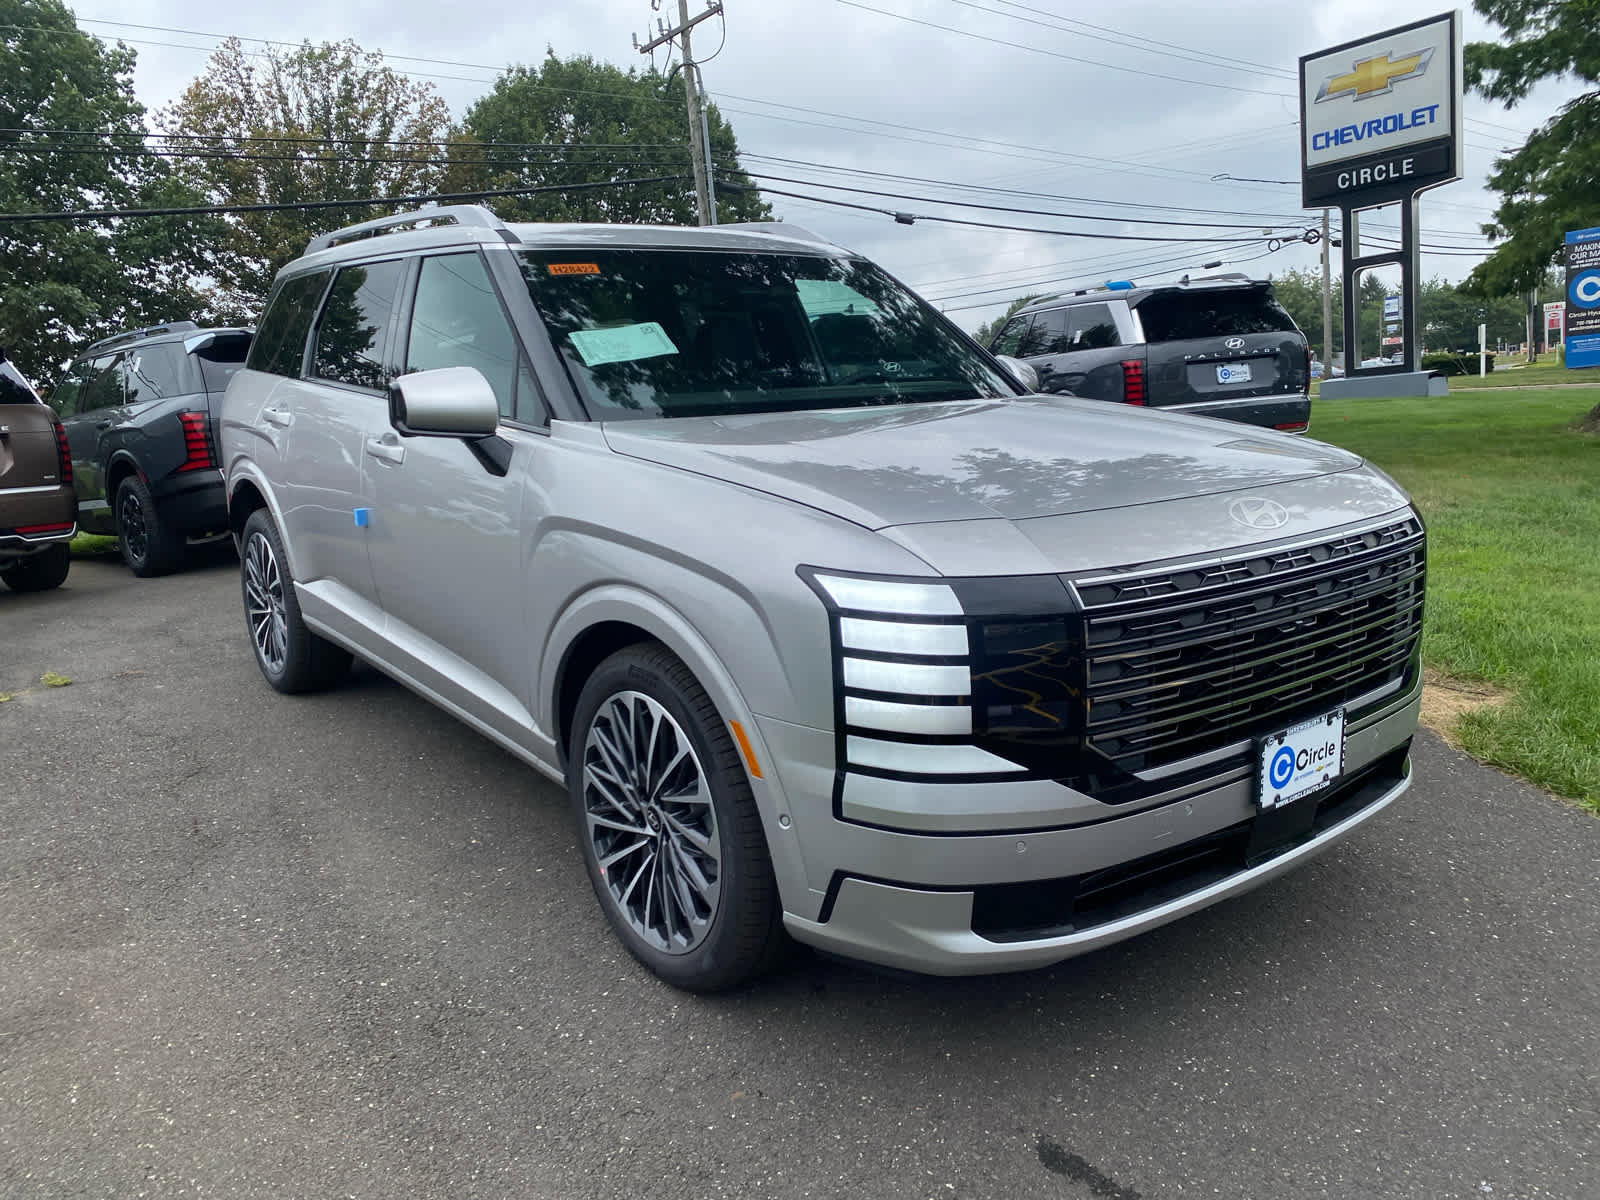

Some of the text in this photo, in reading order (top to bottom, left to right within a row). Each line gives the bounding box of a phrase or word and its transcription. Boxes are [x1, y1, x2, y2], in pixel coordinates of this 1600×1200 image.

[1312, 104, 1440, 151] CHEVROLET
[1337, 158, 1415, 189] CIRCLE
[1569, 252, 1587, 261] OUR
[1296, 742, 1335, 771] Circle
